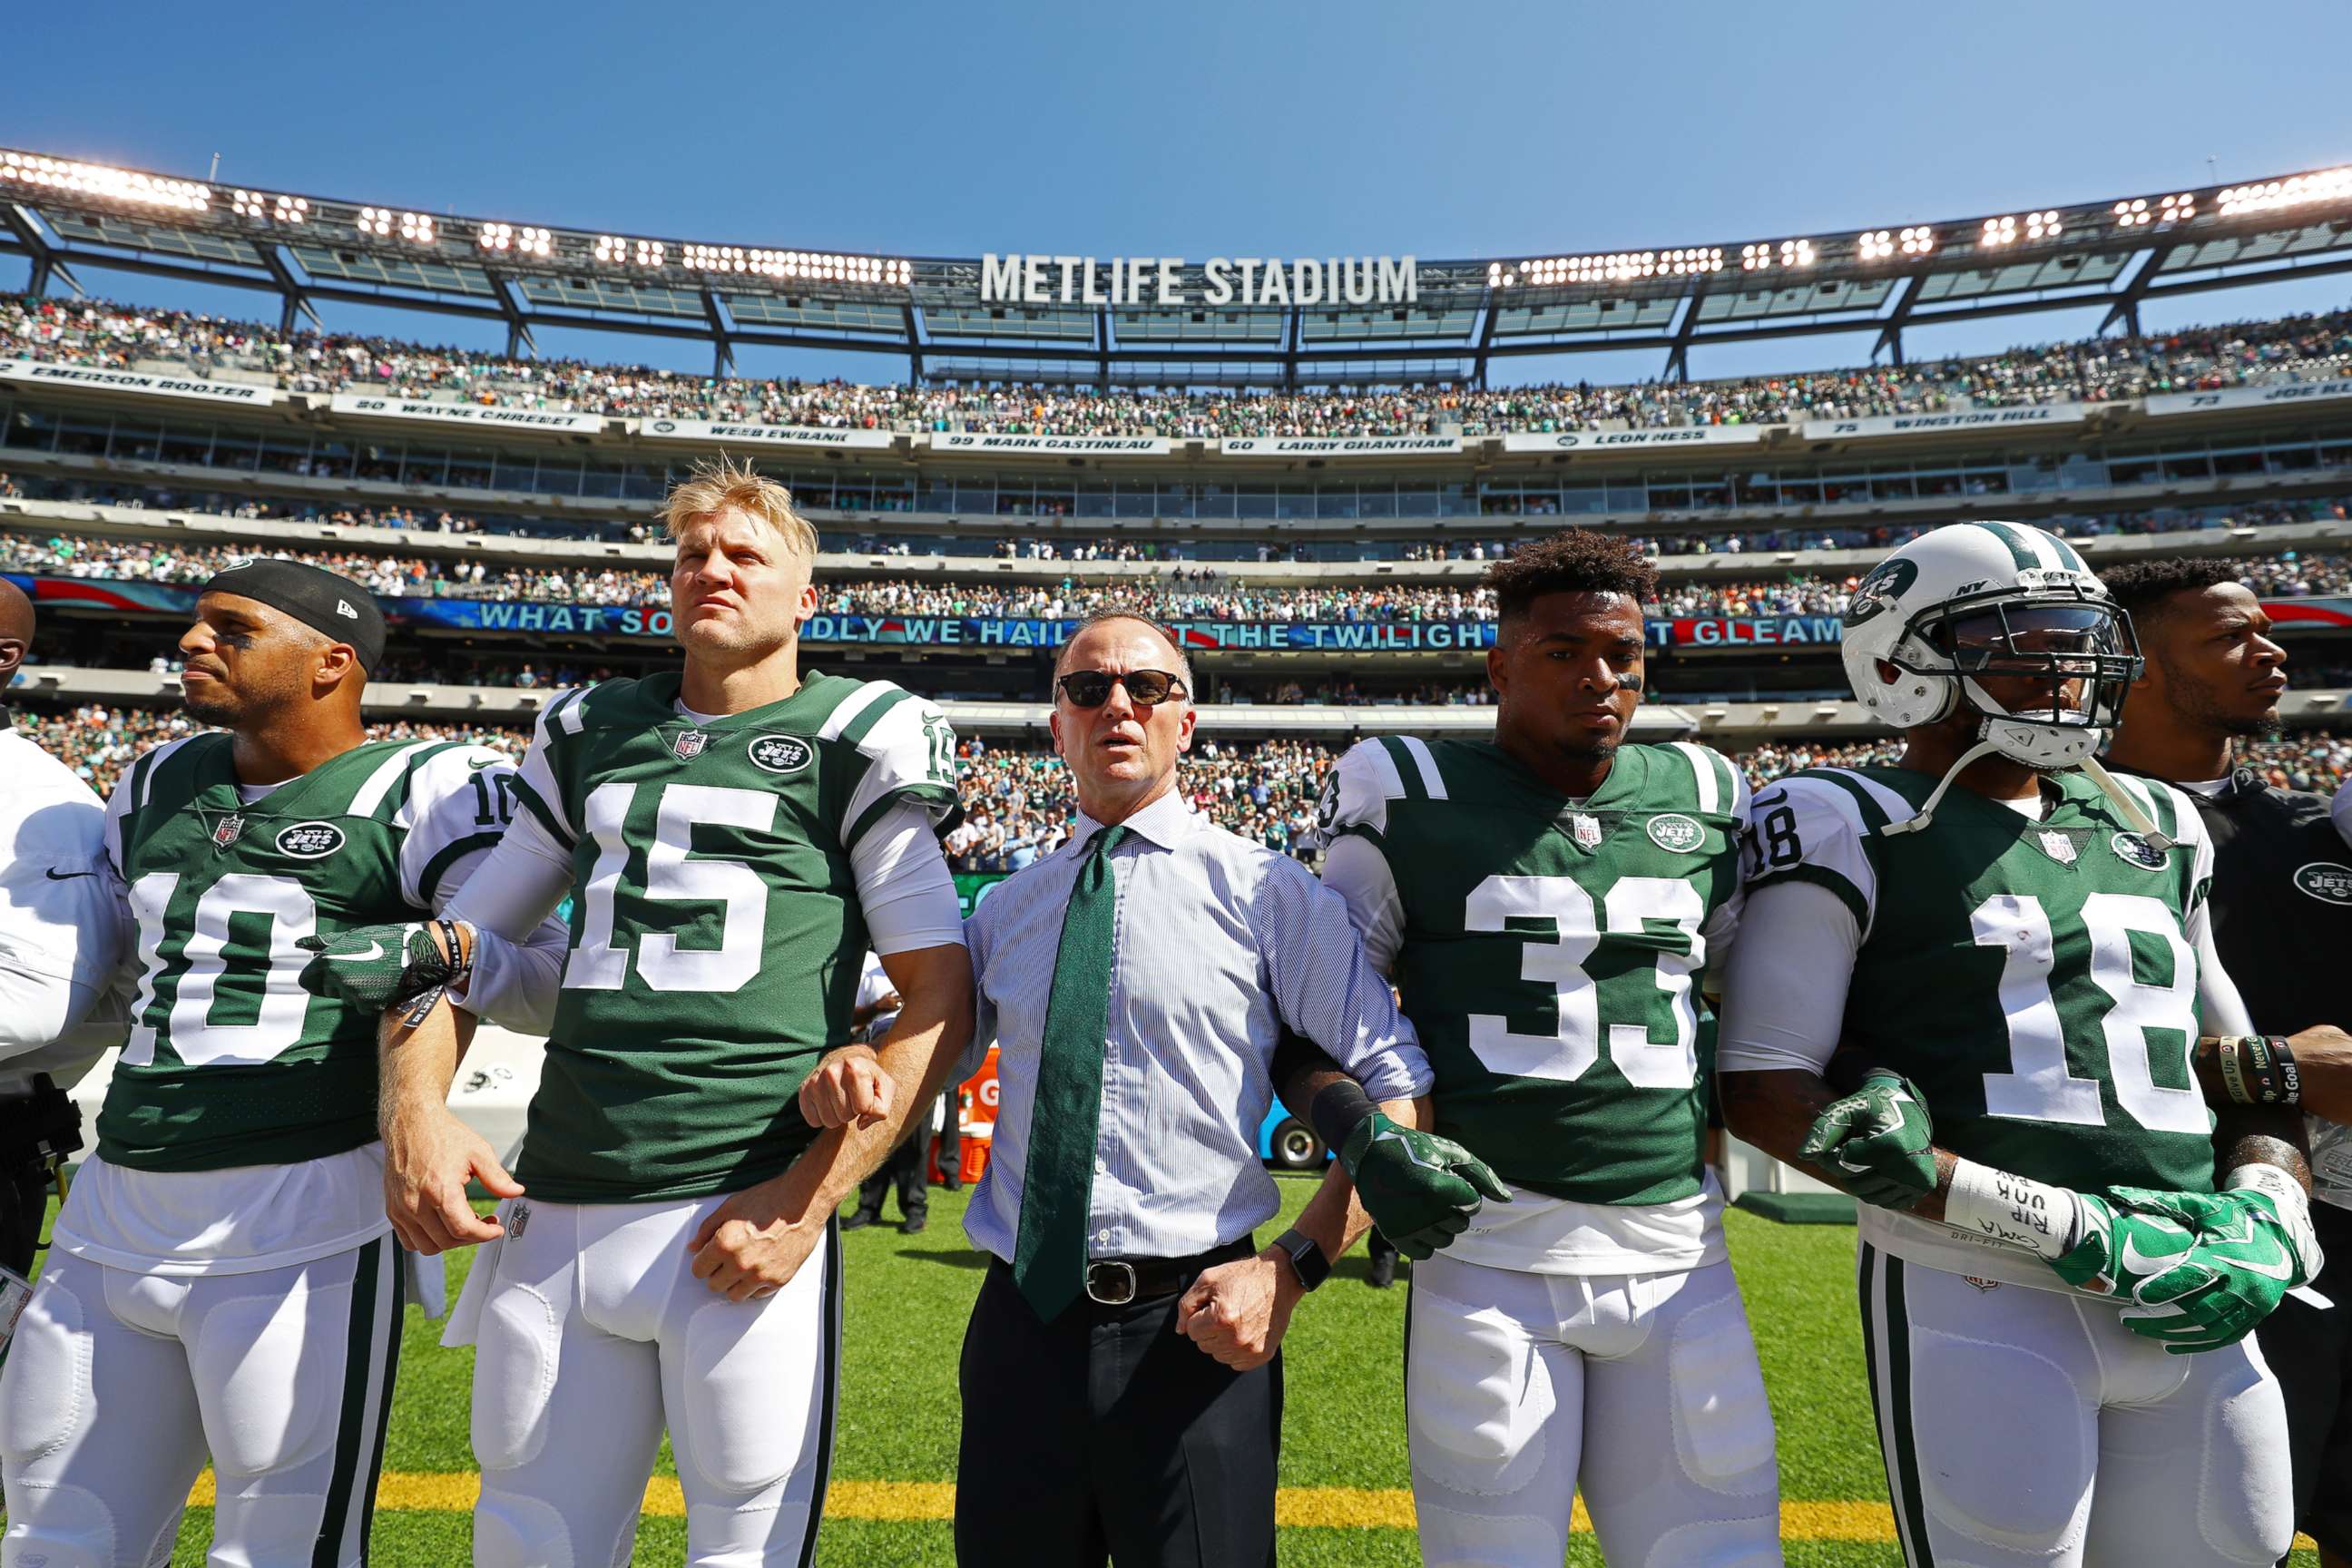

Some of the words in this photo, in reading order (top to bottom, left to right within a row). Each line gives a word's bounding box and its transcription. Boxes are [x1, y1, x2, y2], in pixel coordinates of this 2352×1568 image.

[982, 253, 1185, 305] METLIFE
[1203, 255, 1416, 307] STADIUM
[31, 367, 151, 387] EMERSON
[2265, 386, 2318, 401] JOE
[401, 404, 473, 419] WAYNE
[481, 409, 579, 426] CHREBET
[1894, 413, 1997, 430] WINSTON
[2002, 408, 2052, 422] HILL
[710, 425, 763, 437] WEEB
[767, 428, 849, 443] EWBANK
[948, 436, 975, 446] 99
[982, 436, 1043, 448] MARK
[1045, 438, 1154, 450] GASTINEAU
[1228, 441, 1254, 451] 60
[1277, 440, 1340, 451] LARRY
[1344, 438, 1455, 450] GRANTHAM
[1594, 433, 1649, 445] LEON
[1651, 429, 1707, 442] HESS
[1955, 579, 1990, 596] NY
[480, 603, 603, 632] WHAT
[620, 609, 673, 635] SO
[904, 618, 962, 643] WE
[980, 621, 1068, 646] HAIL
[1171, 622, 1196, 647] T
[1211, 623, 1289, 647] THE
[1308, 622, 1499, 648] TWILIGHT
[676, 740, 699, 754] NFL
[758, 744, 802, 762] JETS
[922, 725, 956, 785] 15
[468, 771, 514, 826] 10
[285, 831, 334, 847] JETS
[1576, 826, 1598, 841] NFL
[1655, 825, 1694, 838] JETS
[1745, 805, 1804, 878] 18
[562, 782, 780, 993] 15
[118, 871, 317, 1067] 10
[1464, 874, 1707, 1090] 33
[1968, 891, 2214, 1135] 18
[2223, 1059, 2237, 1074] Up
[2250, 1043, 2268, 1070] Never
[2279, 1062, 2299, 1091] Goal
[978, 1078, 1000, 1106] G
[2262, 1089, 2278, 1101] Up
[2010, 1205, 2052, 1236] RIP
[1950, 1230, 2007, 1250] DRI-FIT
